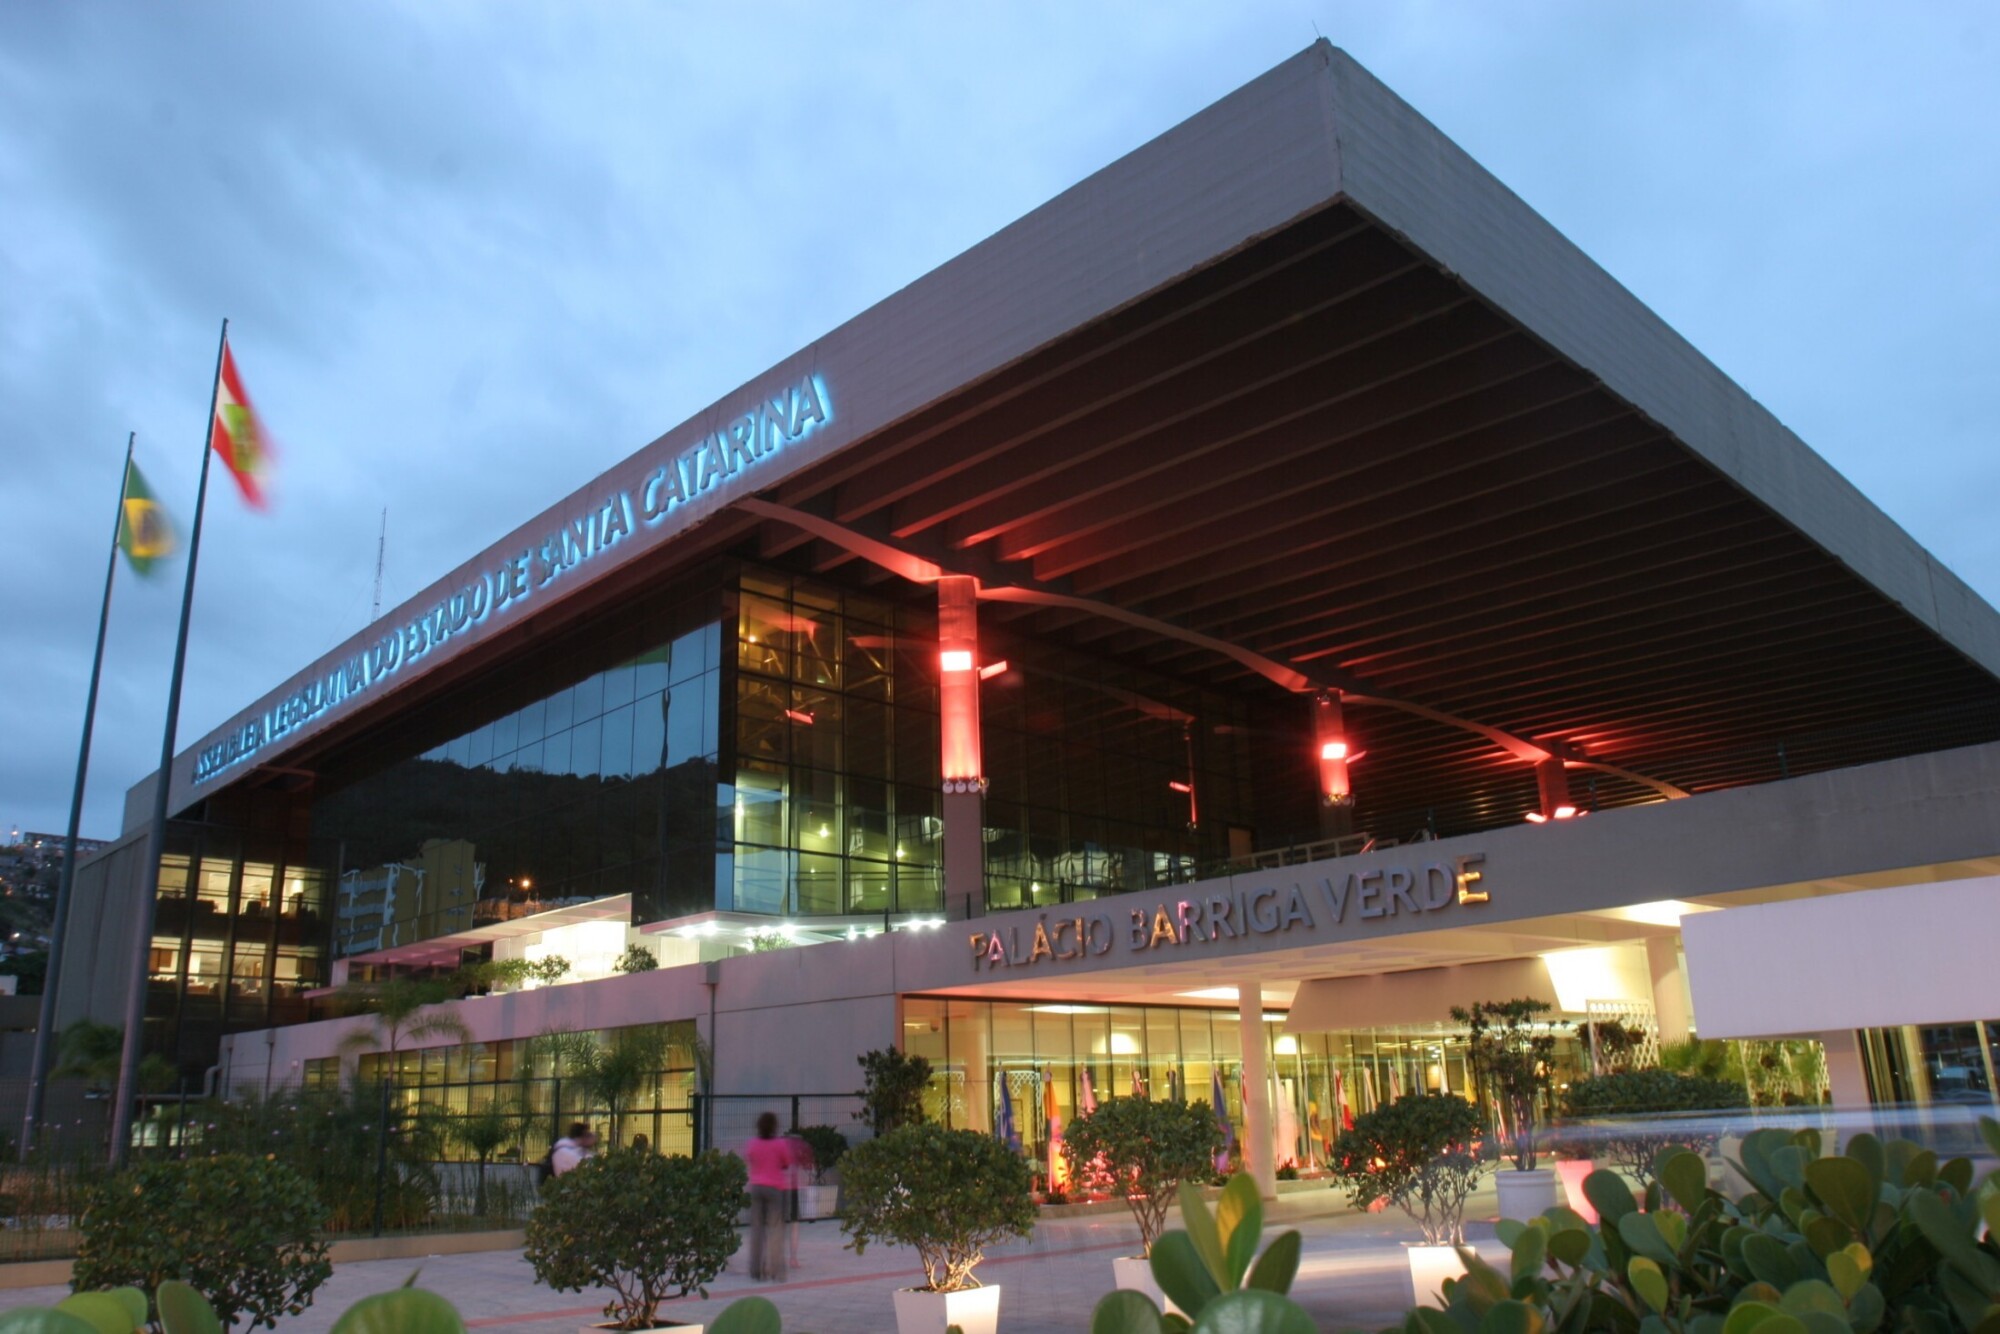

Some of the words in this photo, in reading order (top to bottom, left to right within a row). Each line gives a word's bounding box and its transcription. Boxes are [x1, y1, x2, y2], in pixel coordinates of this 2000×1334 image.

[268, 654, 367, 738] LEGISLATIVA
[367, 631, 402, 680] DO
[403, 575, 488, 662] ESTADO
[494, 549, 529, 609] DE
[536, 492, 630, 586] SANTA
[638, 375, 826, 521] CATARINA
[969, 912, 1114, 971] PALÁCIO
[1129, 882, 1315, 952] BARRIGA
[1320, 852, 1490, 922] VERDE
